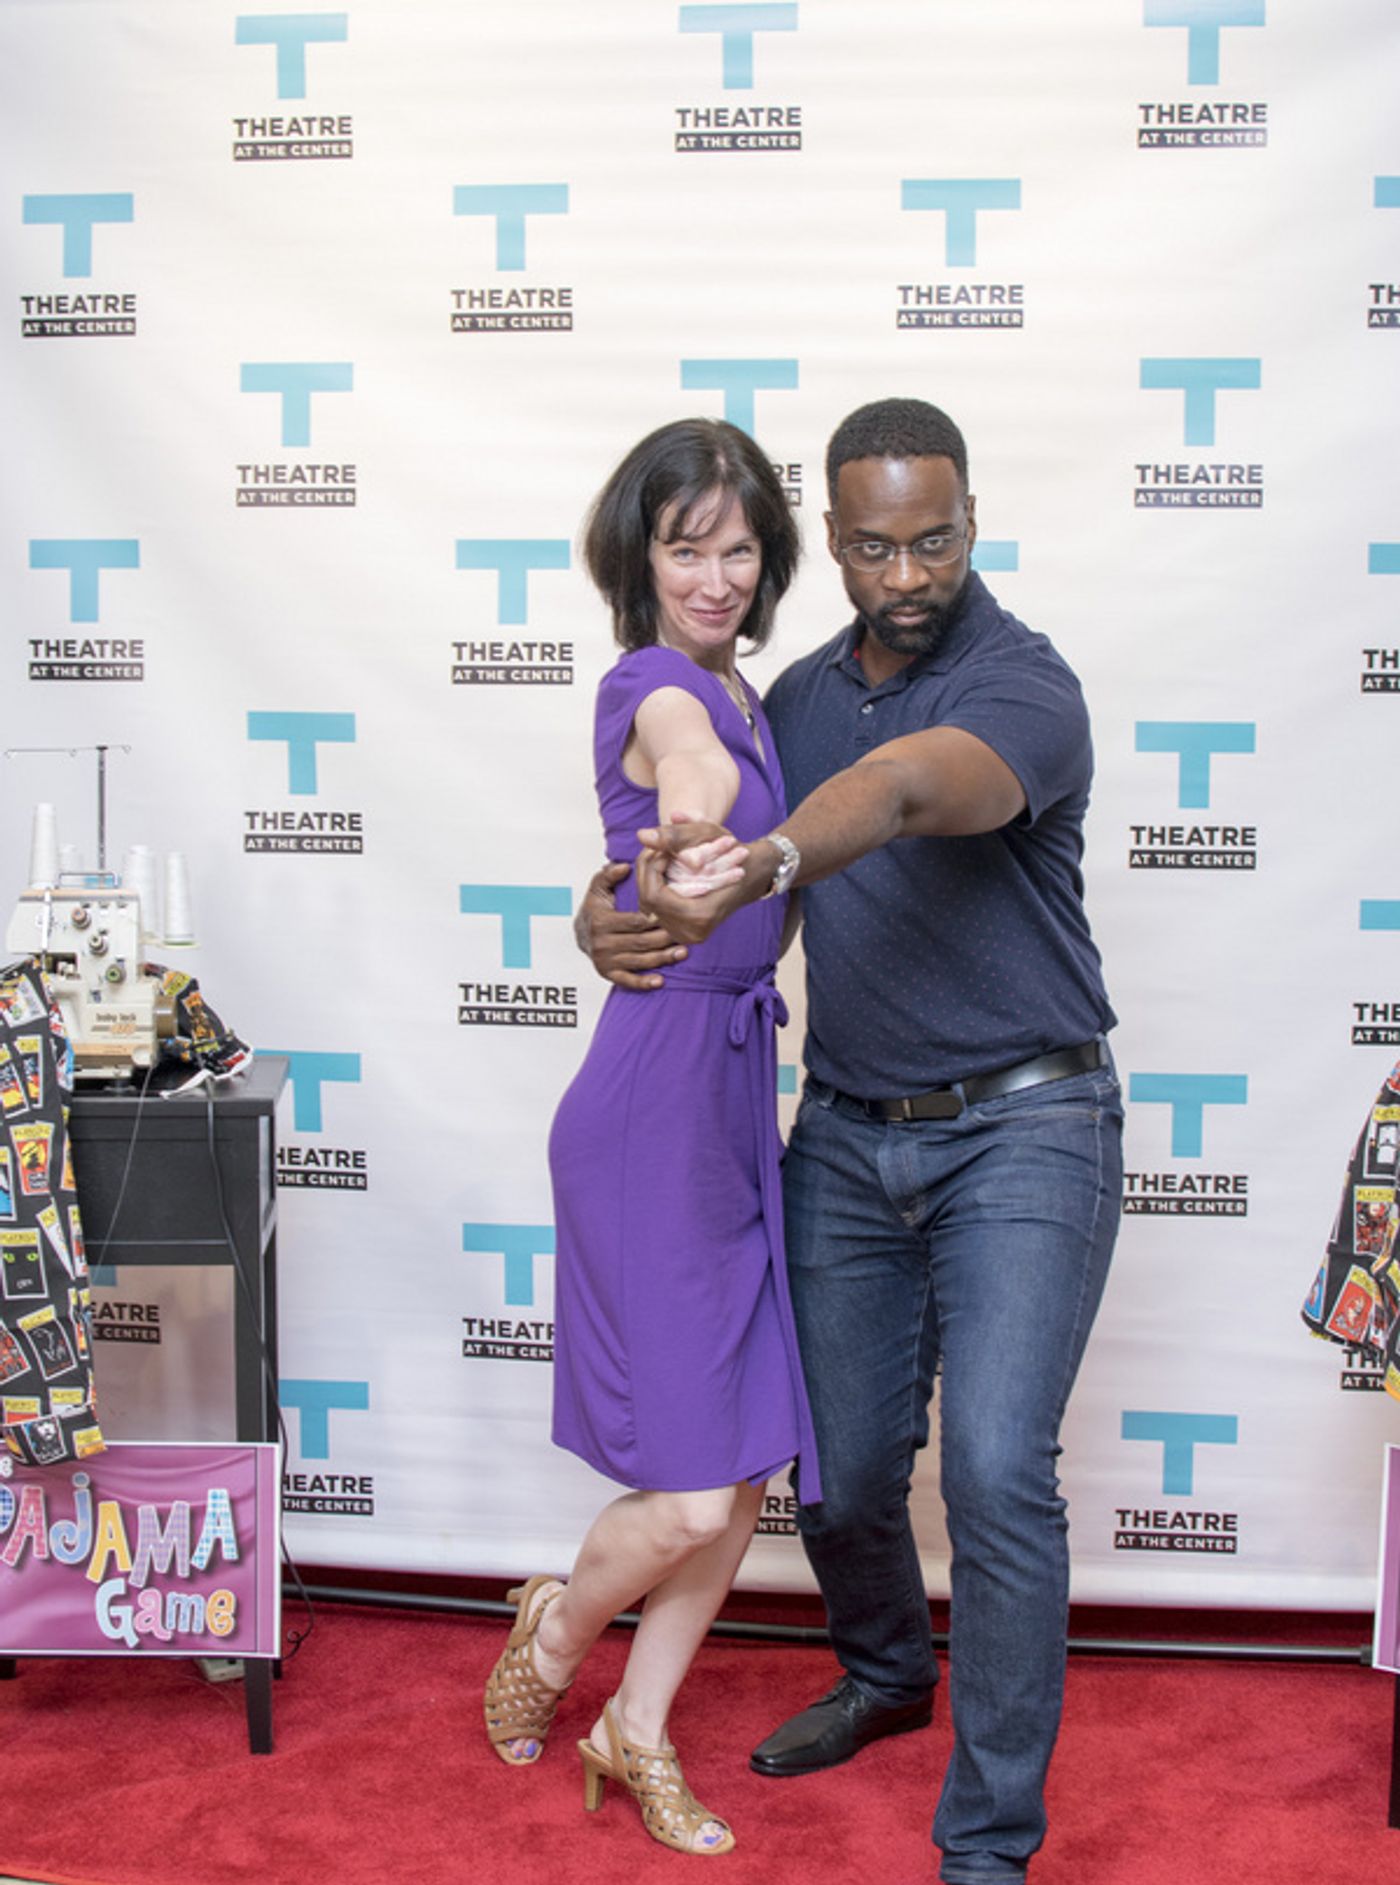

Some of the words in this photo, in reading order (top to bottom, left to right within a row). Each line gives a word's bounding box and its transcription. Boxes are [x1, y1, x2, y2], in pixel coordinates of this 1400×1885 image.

[679, 2, 798, 89] T
[1143, 0, 1265, 85] T
[235, 13, 348, 98] T
[676, 107, 801, 128] THEATRE
[1139, 104, 1267, 124] THEATRE
[233, 116, 352, 137] THEATRE
[677, 136, 696, 148] AT
[700, 135, 731, 148] THE
[736, 134, 799, 147] CENTER
[1140, 132, 1160, 144] AT
[1164, 132, 1195, 144] THE
[1200, 132, 1264, 144] CENTER
[235, 145, 253, 158] AT
[257, 145, 286, 157] THE
[290, 143, 350, 156] CENTER
[453, 184, 569, 270] T
[901, 179, 1021, 267] T
[22, 192, 134, 278] T
[451, 289, 572, 309] THEATRE
[897, 285, 1023, 304] THEATRE
[21, 295, 136, 314] THEATRE
[23, 322, 41, 334] AT
[45, 322, 73, 334] THE
[77, 321, 134, 333] CENTER
[453, 316, 471, 329] AT
[475, 316, 506, 329] THE
[510, 316, 571, 328] CENTER
[899, 313, 918, 325] AT
[922, 313, 953, 325] THE
[958, 313, 1021, 325] CENTER
[240, 363, 353, 447] T
[1140, 358, 1261, 446] T
[237, 465, 356, 484] THEATRE
[1135, 465, 1263, 485] THEATRE
[238, 491, 256, 503] AT
[260, 491, 290, 503] THE
[294, 491, 354, 503] CENTER
[1136, 492, 1156, 504] AT
[1160, 492, 1192, 504] THE
[1196, 492, 1261, 504] CENTER
[29, 540, 140, 623] T
[456, 539, 570, 625] T
[29, 640, 143, 659] THEATRE
[452, 642, 573, 661] THEATRE
[30, 665, 48, 677] AT
[52, 665, 80, 677] THE
[84, 666, 141, 677] CENTER
[454, 669, 472, 681] AT
[476, 669, 506, 681] THE
[510, 669, 571, 681] CENTER
[1364, 677, 1383, 689] AT
[247, 711, 356, 795] T
[1135, 721, 1256, 809] T
[245, 812, 362, 831] THEATRE
[247, 838, 265, 849] AT
[269, 838, 298, 850] THE
[302, 839, 361, 851] CENTER
[1130, 826, 1256, 846] THEATRE
[1131, 853, 1150, 866] AT
[1154, 853, 1186, 866] THE
[1190, 854, 1254, 866] CENTER
[460, 884, 573, 969] T
[459, 984, 577, 1005] THEATRE
[461, 1010, 479, 1022] AT
[483, 1010, 512, 1023] THE
[516, 1011, 575, 1024] CENTER
[1355, 1030, 1373, 1042] AT
[1378, 1031, 1400, 1042] TH
[1129, 1072, 1248, 1158] T
[308, 1174, 366, 1187] CENTER
[1124, 1173, 1248, 1193] THEATRE
[1126, 1200, 1145, 1211] AT
[1149, 1200, 1179, 1212] THE
[1183, 1201, 1245, 1213] CENTER
[462, 1318, 554, 1340] THEAT
[464, 1343, 482, 1354] AT
[486, 1344, 514, 1356] THE
[519, 1346, 554, 1359] CEN
[1344, 1376, 1363, 1387] AT
[1121, 1411, 1239, 1496] T
[314, 1499, 371, 1512] CENTER
[1115, 1509, 1237, 1531] THEATRE
[1117, 1535, 1135, 1547] AT
[1139, 1536, 1169, 1548] THE
[1173, 1537, 1234, 1550] CENTER
[95, 1578, 237, 1648] Game
